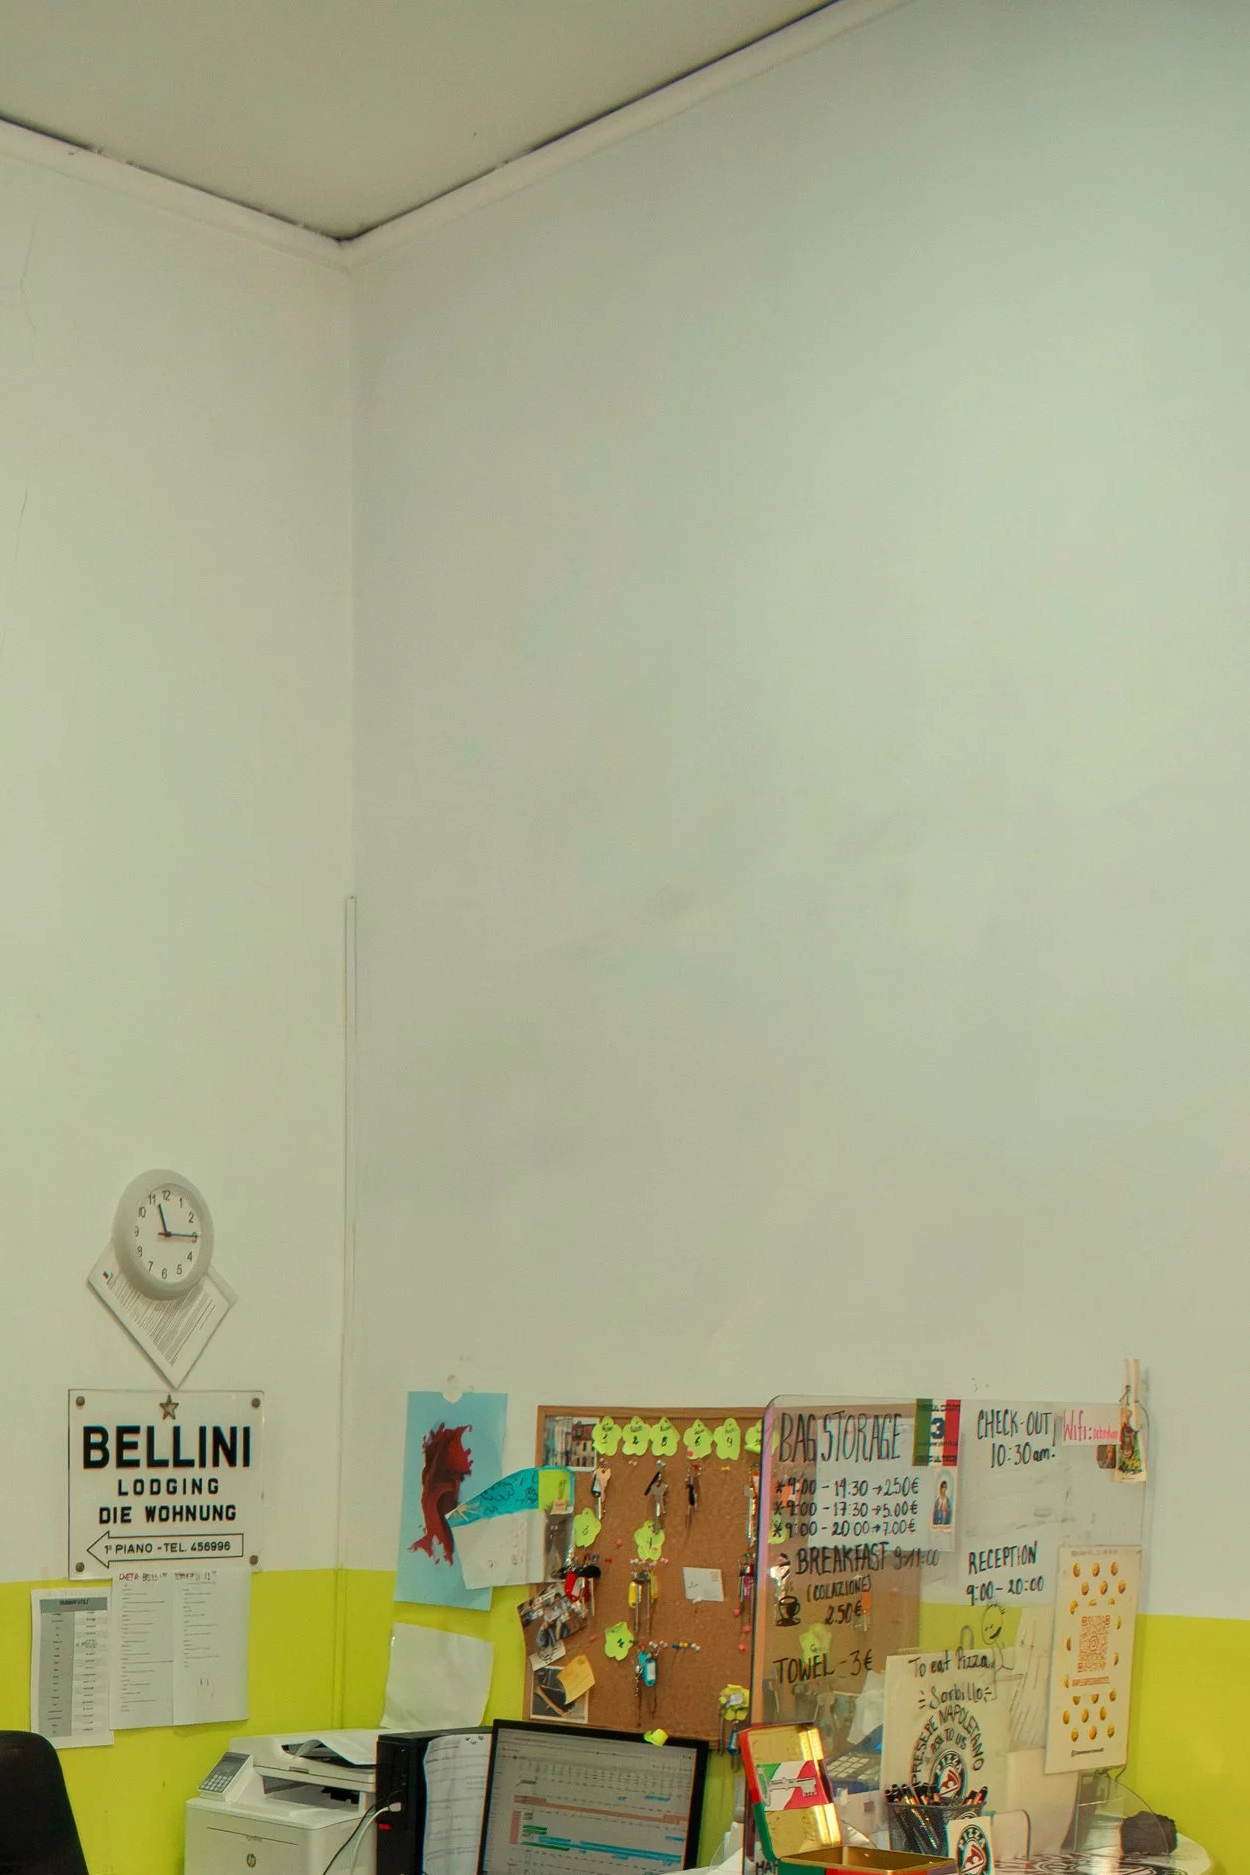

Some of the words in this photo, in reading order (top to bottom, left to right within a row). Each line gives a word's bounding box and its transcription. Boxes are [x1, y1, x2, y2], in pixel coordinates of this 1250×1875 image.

[148, 1194, 156, 1205] 11
[162, 1190, 171, 1201] 12
[179, 1197, 183, 1209] 1
[138, 1206, 146, 1218] 10
[188, 1212, 195, 1223] 2
[187, 1251, 193, 1261] 4
[148, 1261, 153, 1272] 7
[177, 1264, 182, 1275] 5
[161, 1268, 167, 1279] 6
[931, 1417, 945, 1439] 3
[779, 1411, 817, 1462] BAG
[821, 1410, 902, 1463] STORAGE
[83, 1425, 251, 1469] BELLINI
[118, 1478, 219, 1497] LODGING
[99, 1506, 132, 1524] DIE
[145, 1504, 237, 1523] WOHNUNG
[115, 1543, 153, 1554] PIANO
[795, 1541, 890, 1576] BREAKFAST
[968, 1540, 1038, 1575] RECEPTION
[773, 1653, 834, 1684] TOWEL
[908, 1656, 926, 1679] To
[931, 1649, 951, 1674] eat
